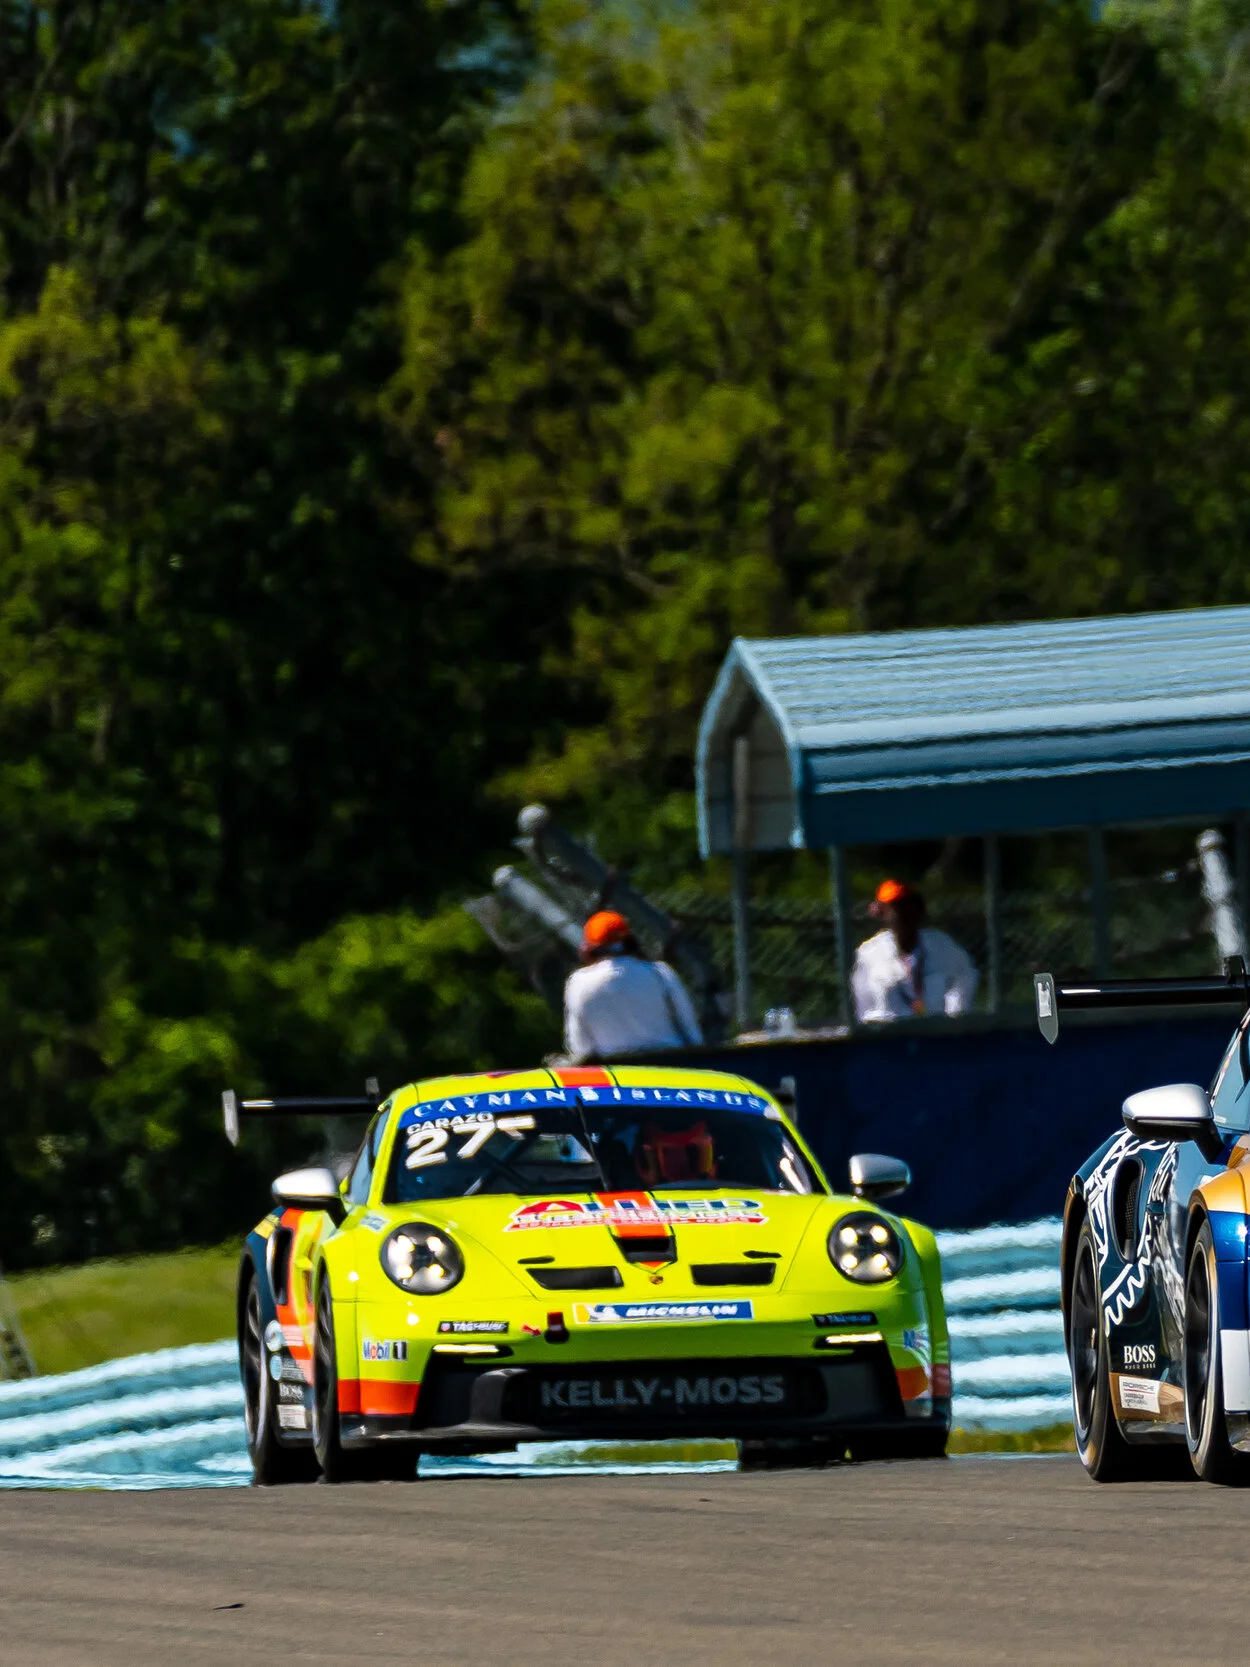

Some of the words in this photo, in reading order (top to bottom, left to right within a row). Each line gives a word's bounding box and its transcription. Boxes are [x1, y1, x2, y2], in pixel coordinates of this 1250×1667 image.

[414, 1089, 567, 1118] CAYMAN
[613, 1087, 761, 1109] ISLANDS
[406, 1111, 494, 1136] CARAZO
[405, 1120, 496, 1170] 27
[625, 1303, 738, 1317] MICHELIN
[363, 1341, 390, 1360] Mobil
[1123, 1344, 1156, 1364] BOSS
